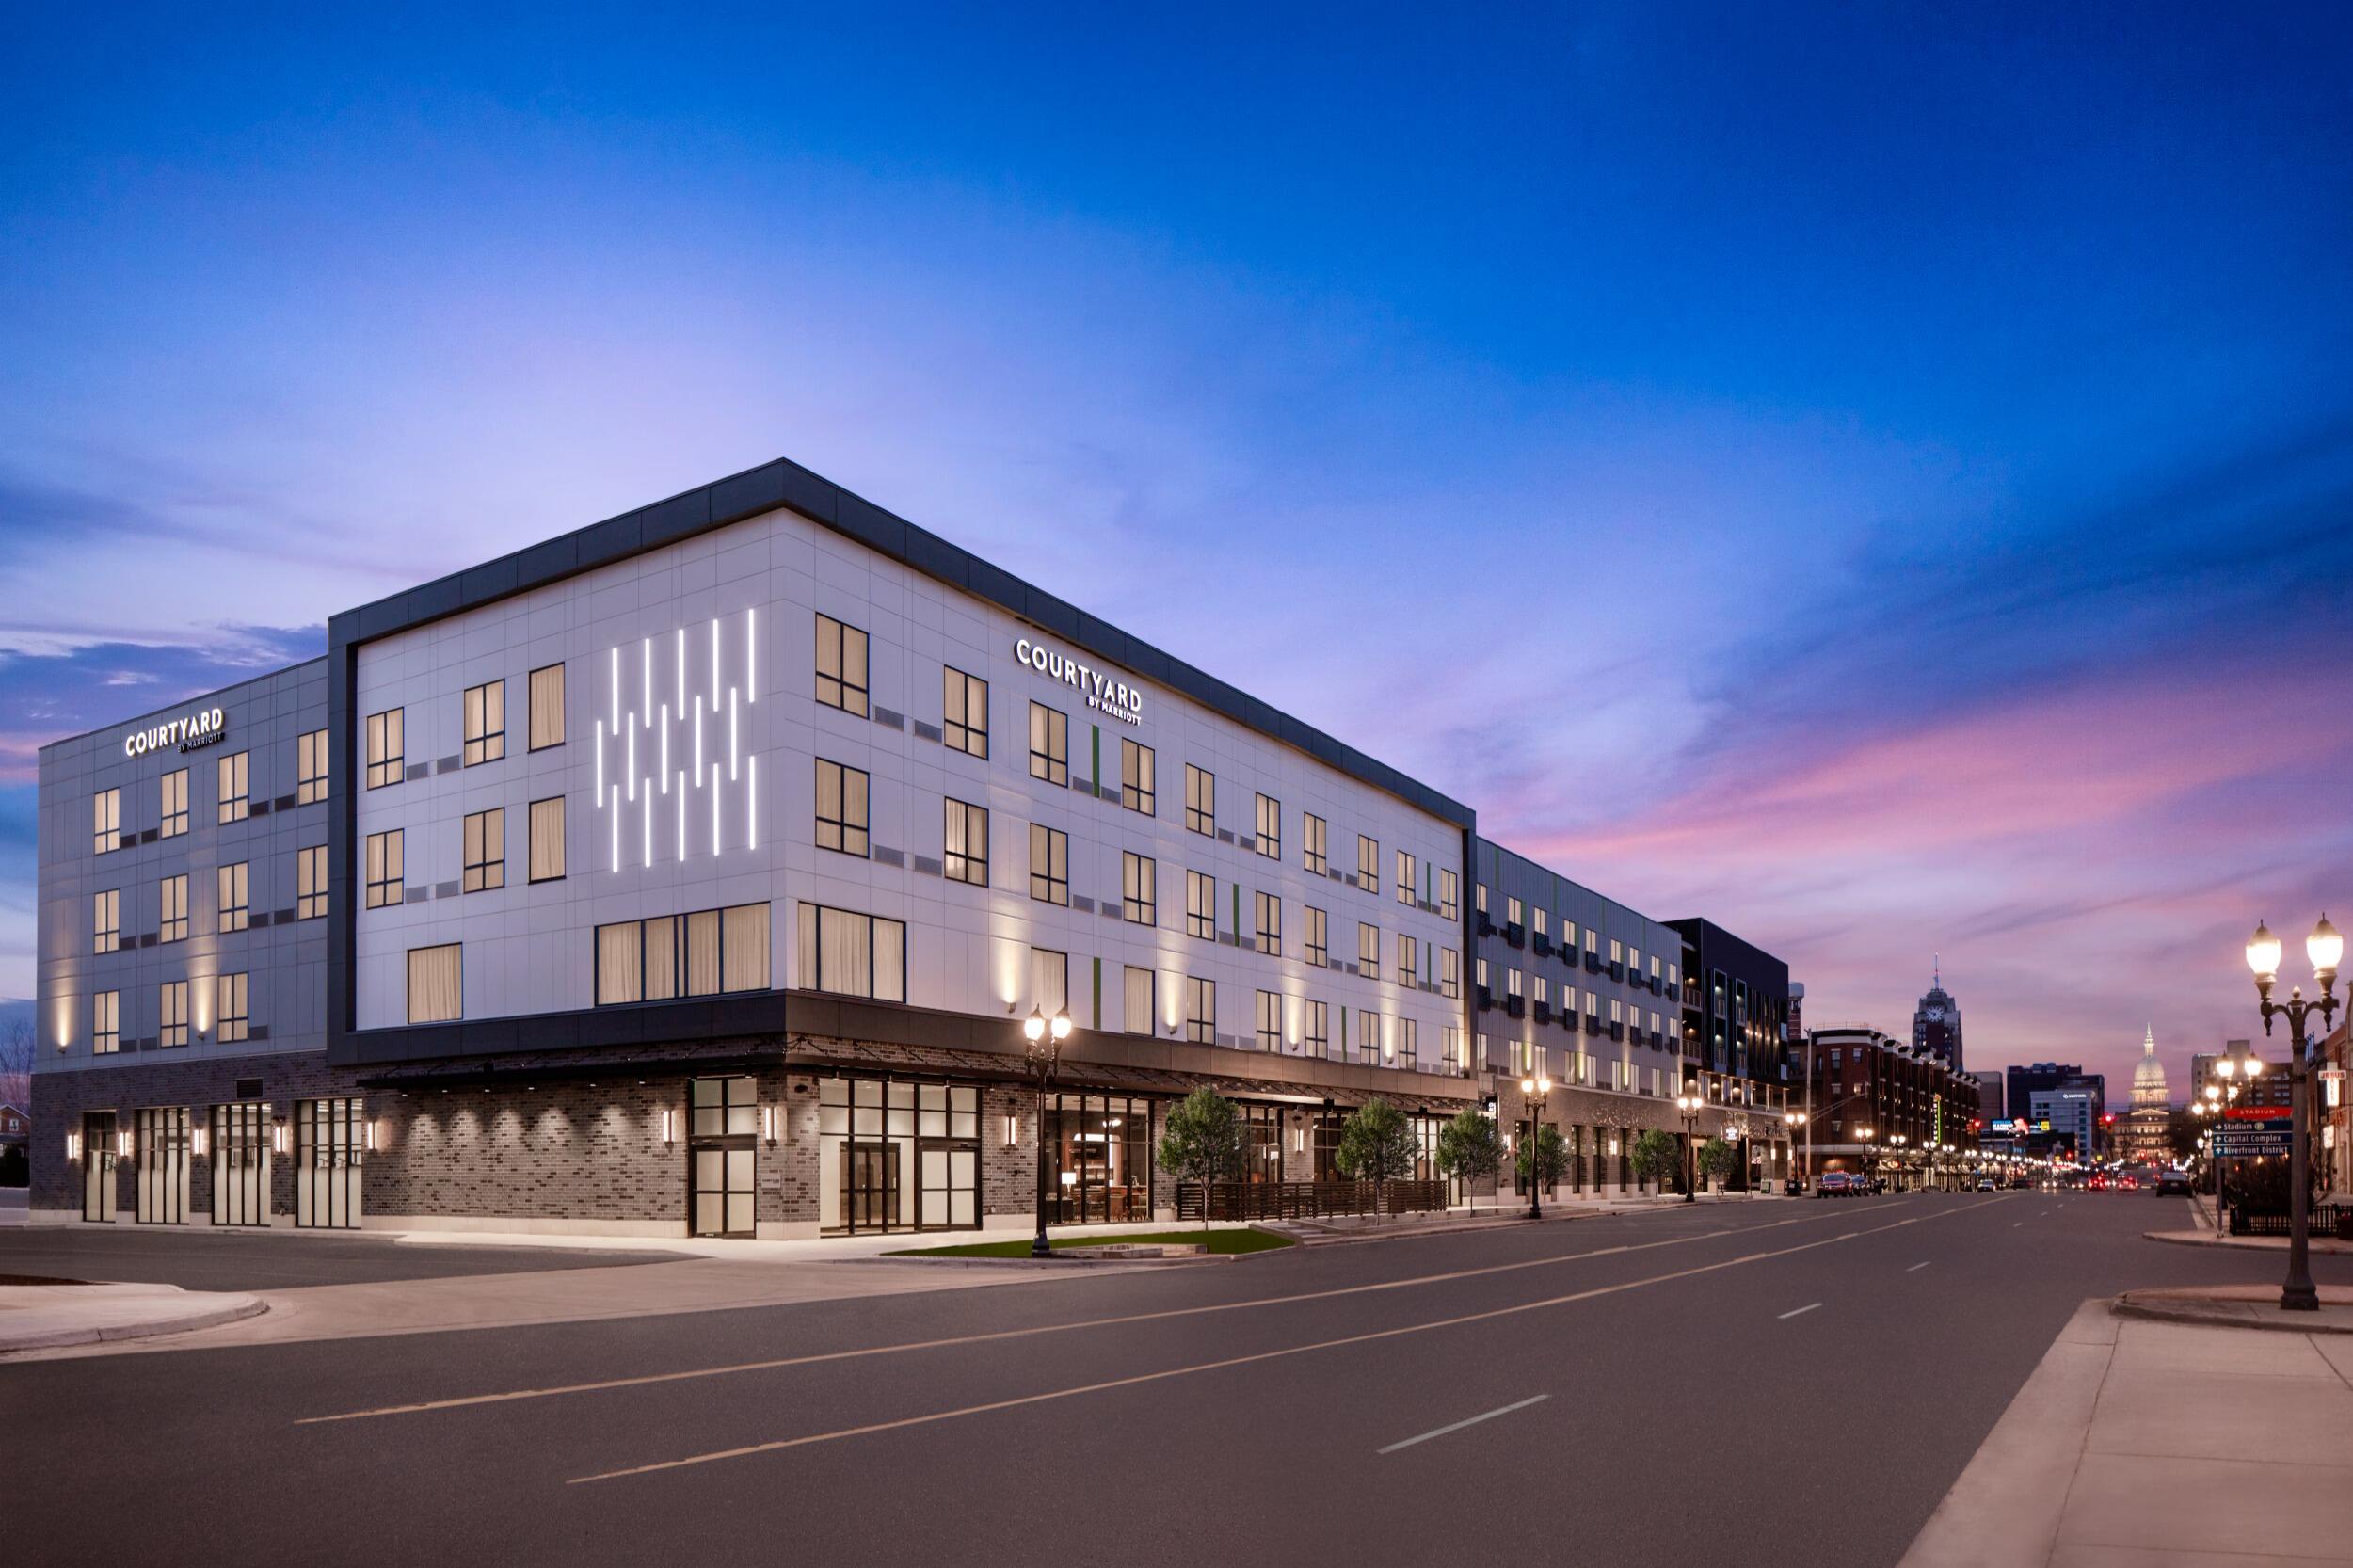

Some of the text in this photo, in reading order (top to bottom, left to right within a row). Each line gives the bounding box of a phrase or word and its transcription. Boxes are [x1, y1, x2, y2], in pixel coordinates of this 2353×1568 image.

[1016, 639, 1142, 712] COURTYARD
[1088, 696, 1142, 726] BY MARRIOTT
[125, 708, 223, 757] COURTYARD
[178, 731, 222, 753] BY MARRIOTT
[2223, 1136, 2281, 1144] Capital Complex
[2223, 1145, 2288, 1155] Riverfront District
